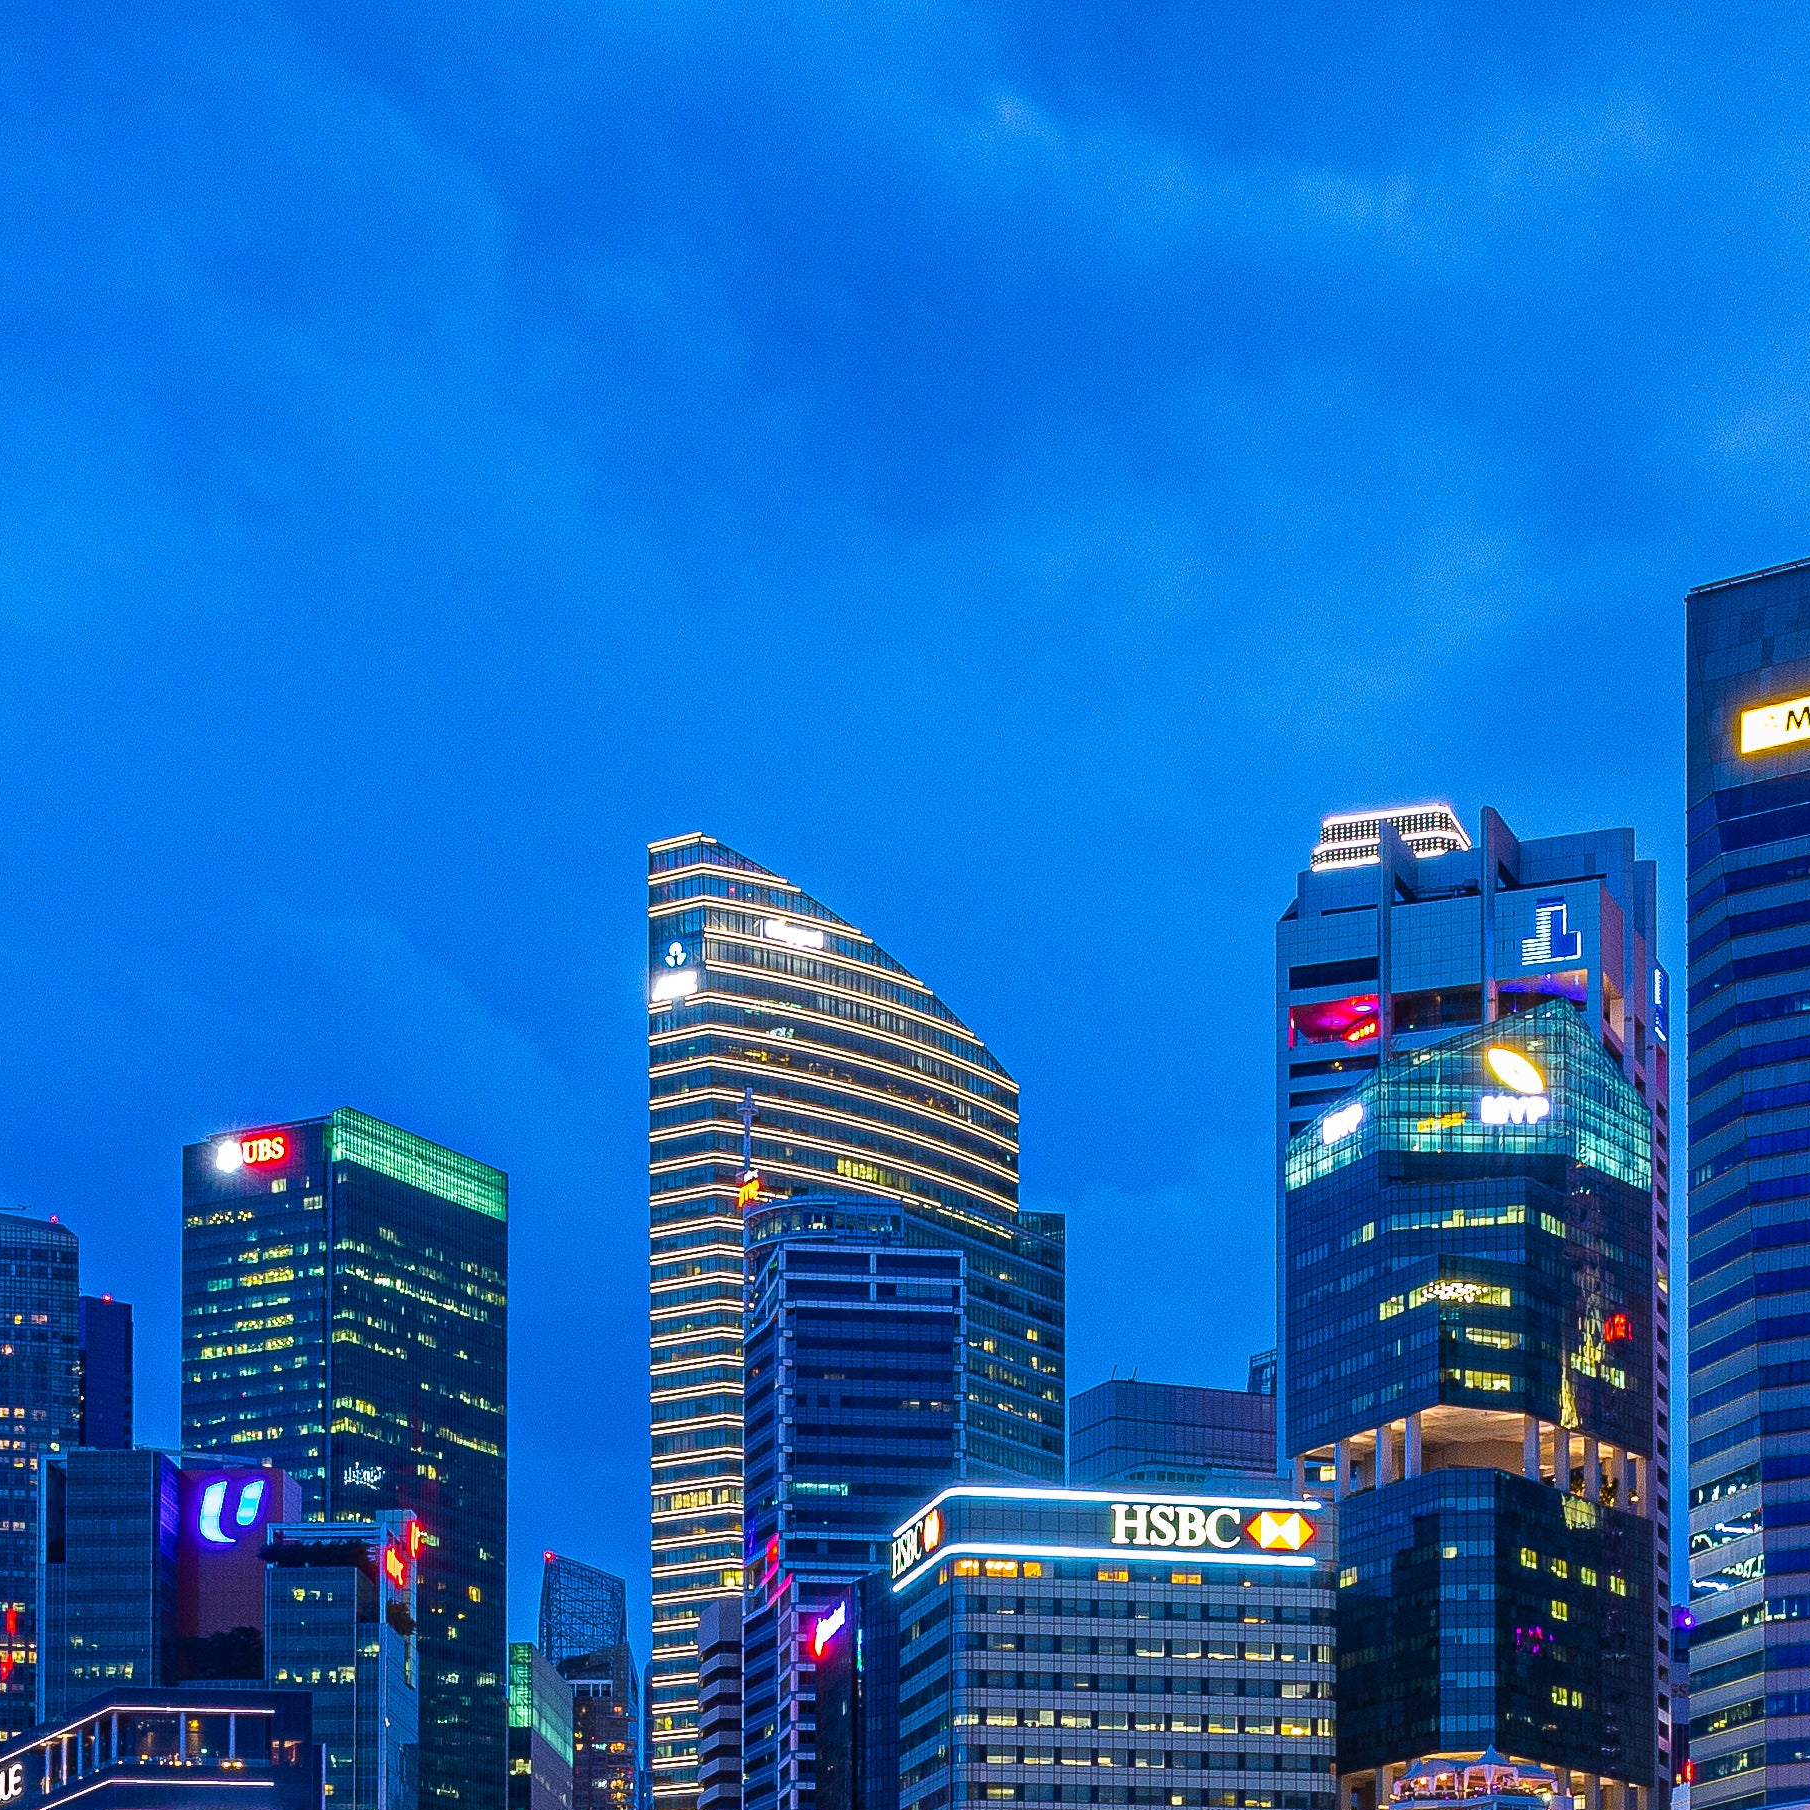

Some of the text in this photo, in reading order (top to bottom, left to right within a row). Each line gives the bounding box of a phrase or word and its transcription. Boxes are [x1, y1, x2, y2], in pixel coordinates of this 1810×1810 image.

[241, 1136, 285, 1164] UBS
[1110, 1503, 1240, 1549] HSBC
[891, 1519, 924, 1580] HSBC
